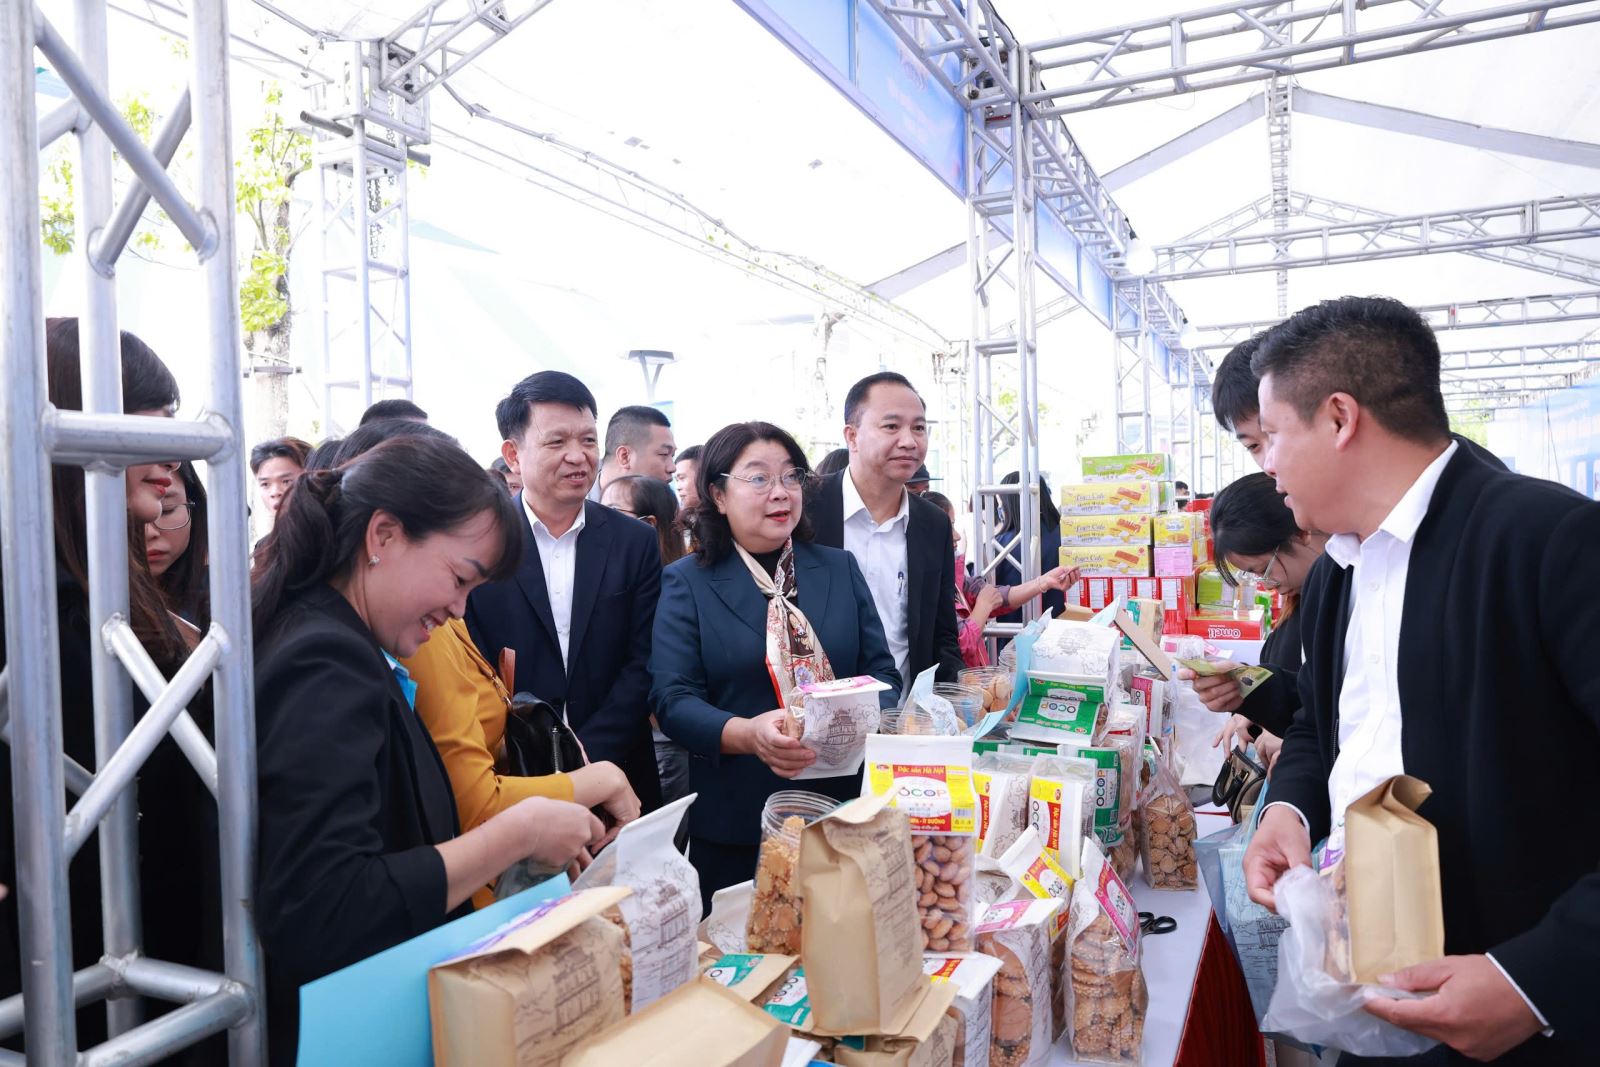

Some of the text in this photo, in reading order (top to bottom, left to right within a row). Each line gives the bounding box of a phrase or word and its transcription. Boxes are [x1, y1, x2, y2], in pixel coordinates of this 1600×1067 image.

[1041, 702, 1076, 713] OCOP
[899, 787, 946, 797] OCOP
[1096, 769, 1105, 807] OCOP
